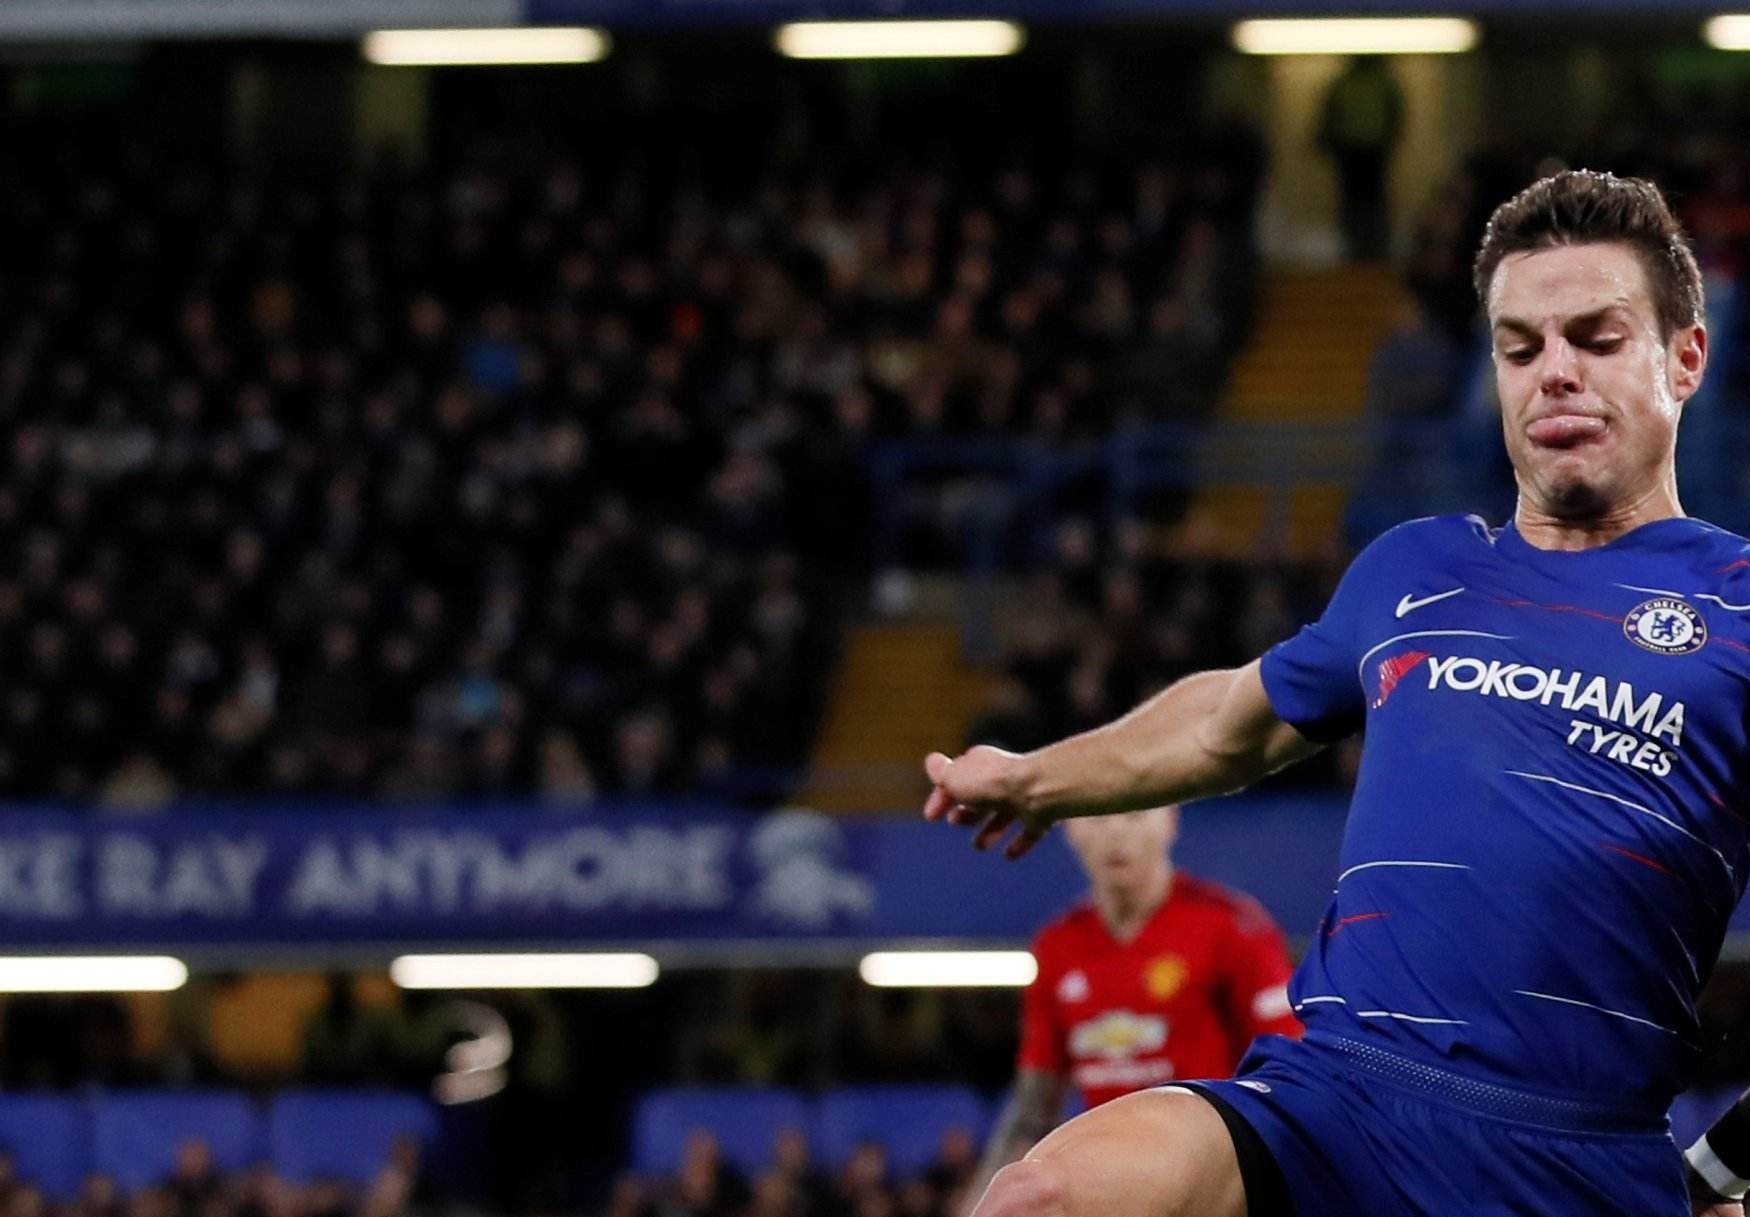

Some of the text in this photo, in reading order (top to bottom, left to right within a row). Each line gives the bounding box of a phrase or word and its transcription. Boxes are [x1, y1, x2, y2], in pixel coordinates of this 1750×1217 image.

[1643, 600, 1697, 620] CHELSEA
[1427, 656, 1685, 746] YOKOHAMA
[1567, 719, 1678, 777] TYRES
[98, 828, 270, 918] RAY
[286, 824, 735, 914] ANYMORE
